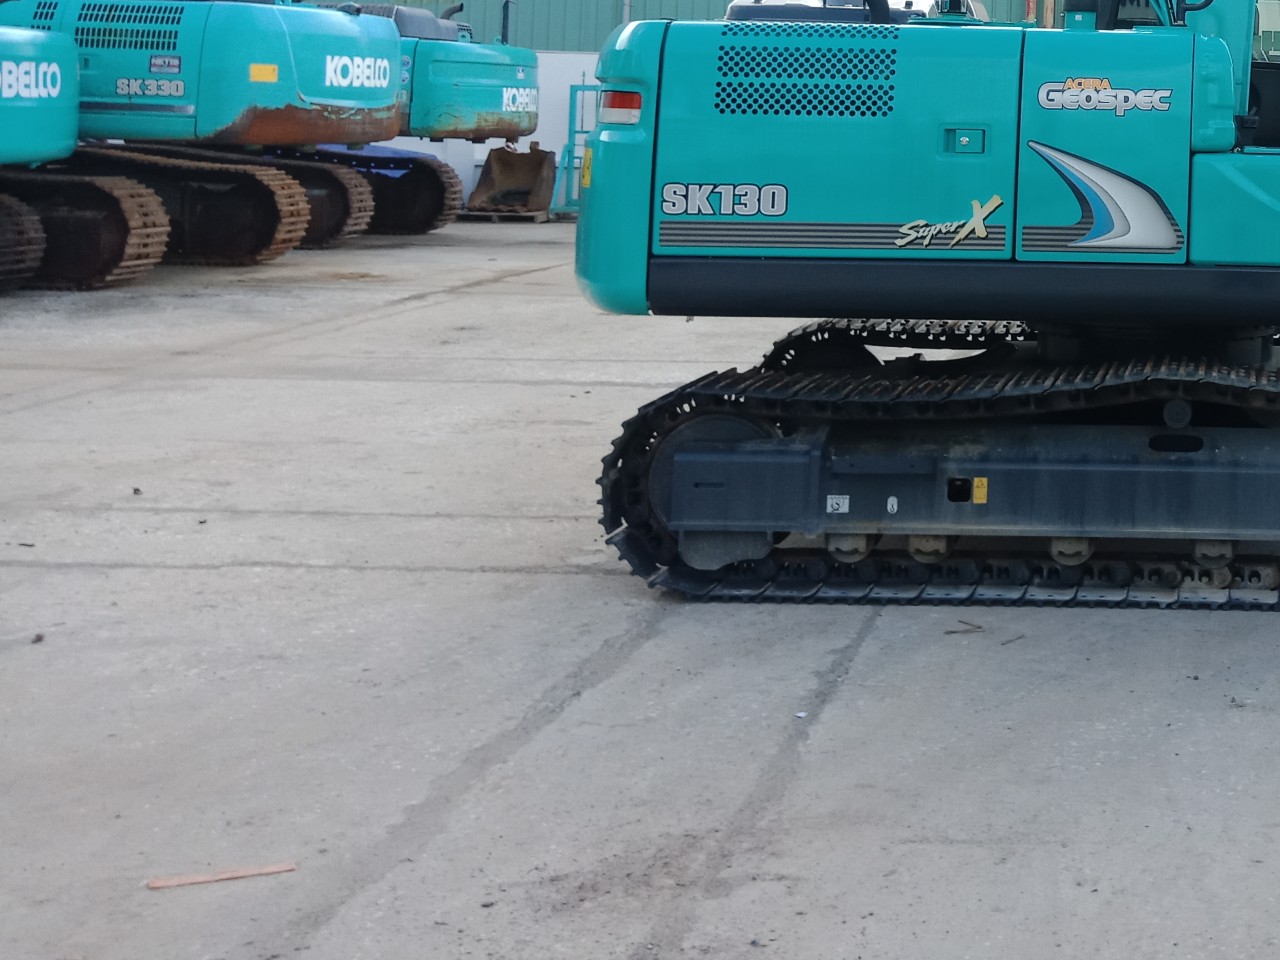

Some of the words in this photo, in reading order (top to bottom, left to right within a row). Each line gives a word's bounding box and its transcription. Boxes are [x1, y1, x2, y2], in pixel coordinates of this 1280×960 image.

[116, 77, 185, 97] SK330
[325, 54, 390, 89] KOBELCO
[1063, 77, 1112, 91] ACERA
[661, 182, 789, 217] SK130
[894, 219, 966, 248] Super
[949, 193, 1004, 248] X
